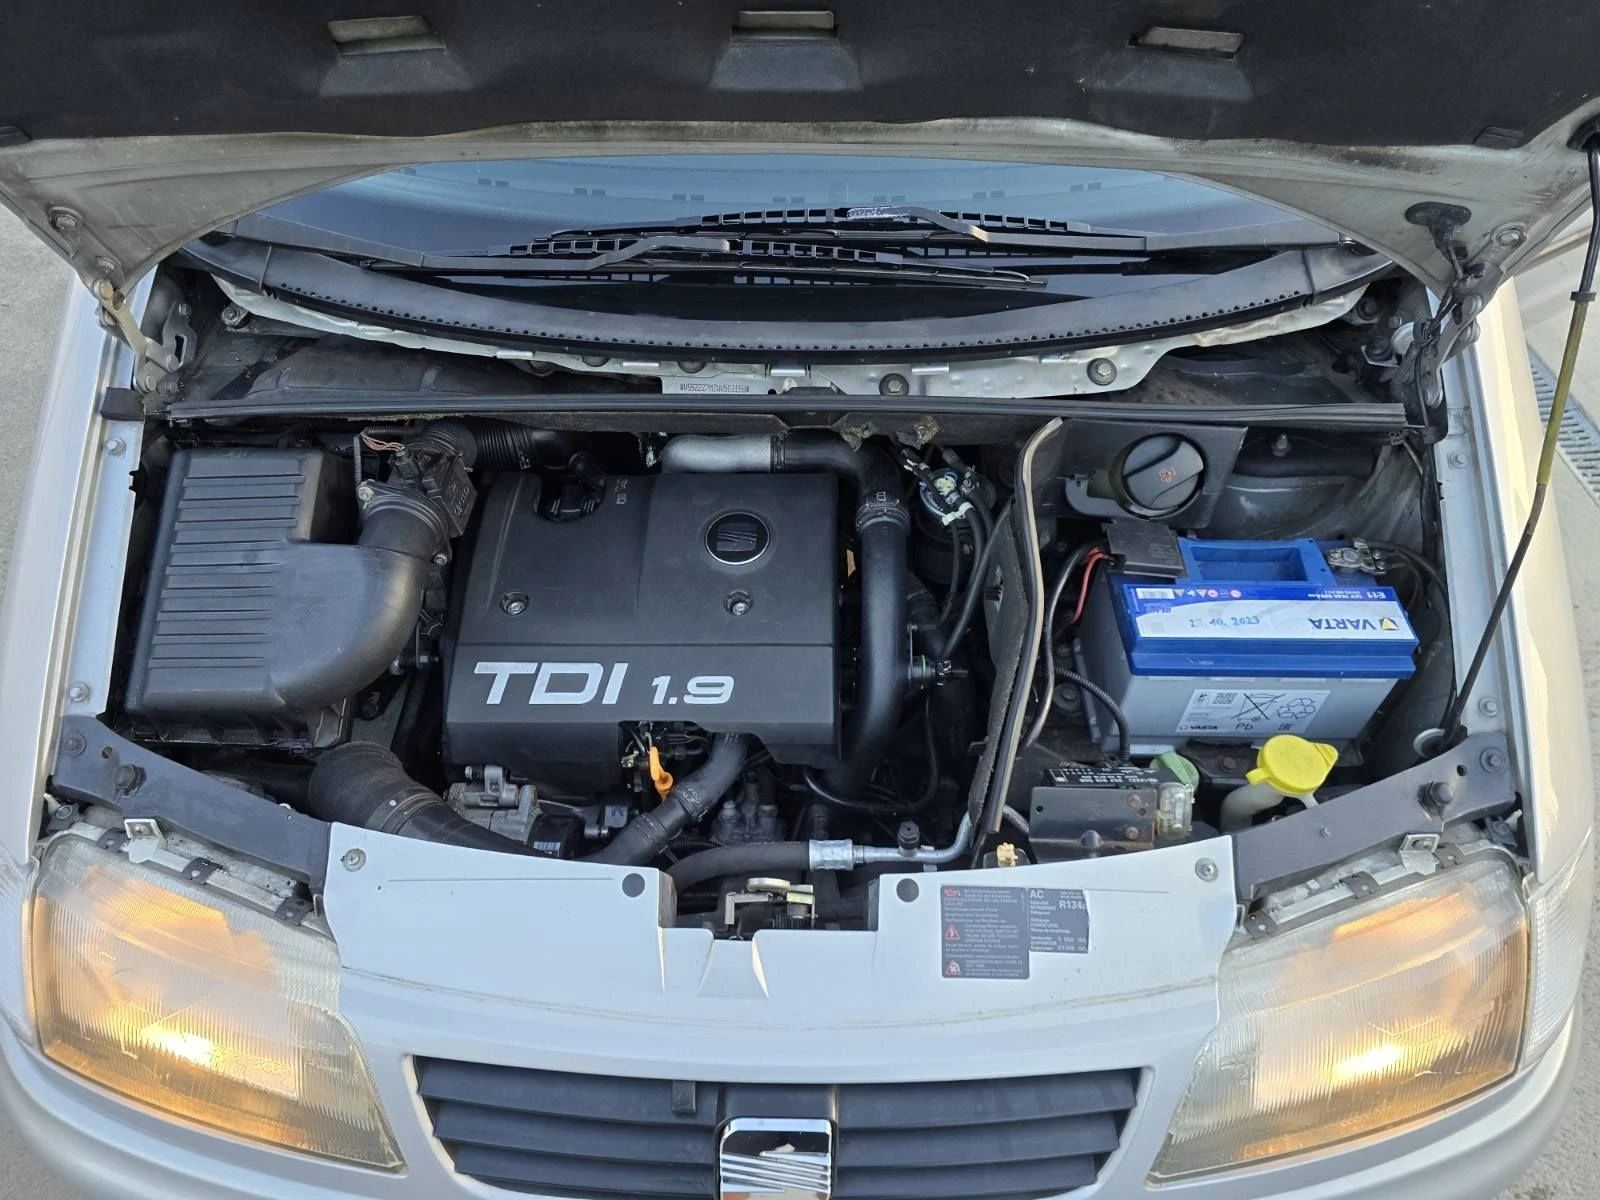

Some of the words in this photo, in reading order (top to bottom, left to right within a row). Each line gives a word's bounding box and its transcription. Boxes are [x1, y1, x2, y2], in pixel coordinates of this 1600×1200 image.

[1230, 615, 1260, 625] 2023
[1308, 618, 1376, 630] VARTA
[473, 662, 629, 704] TDI
[651, 675, 735, 704] 1.9
[1235, 723, 1254, 731] Pb
[1029, 889, 1044, 899] AC
